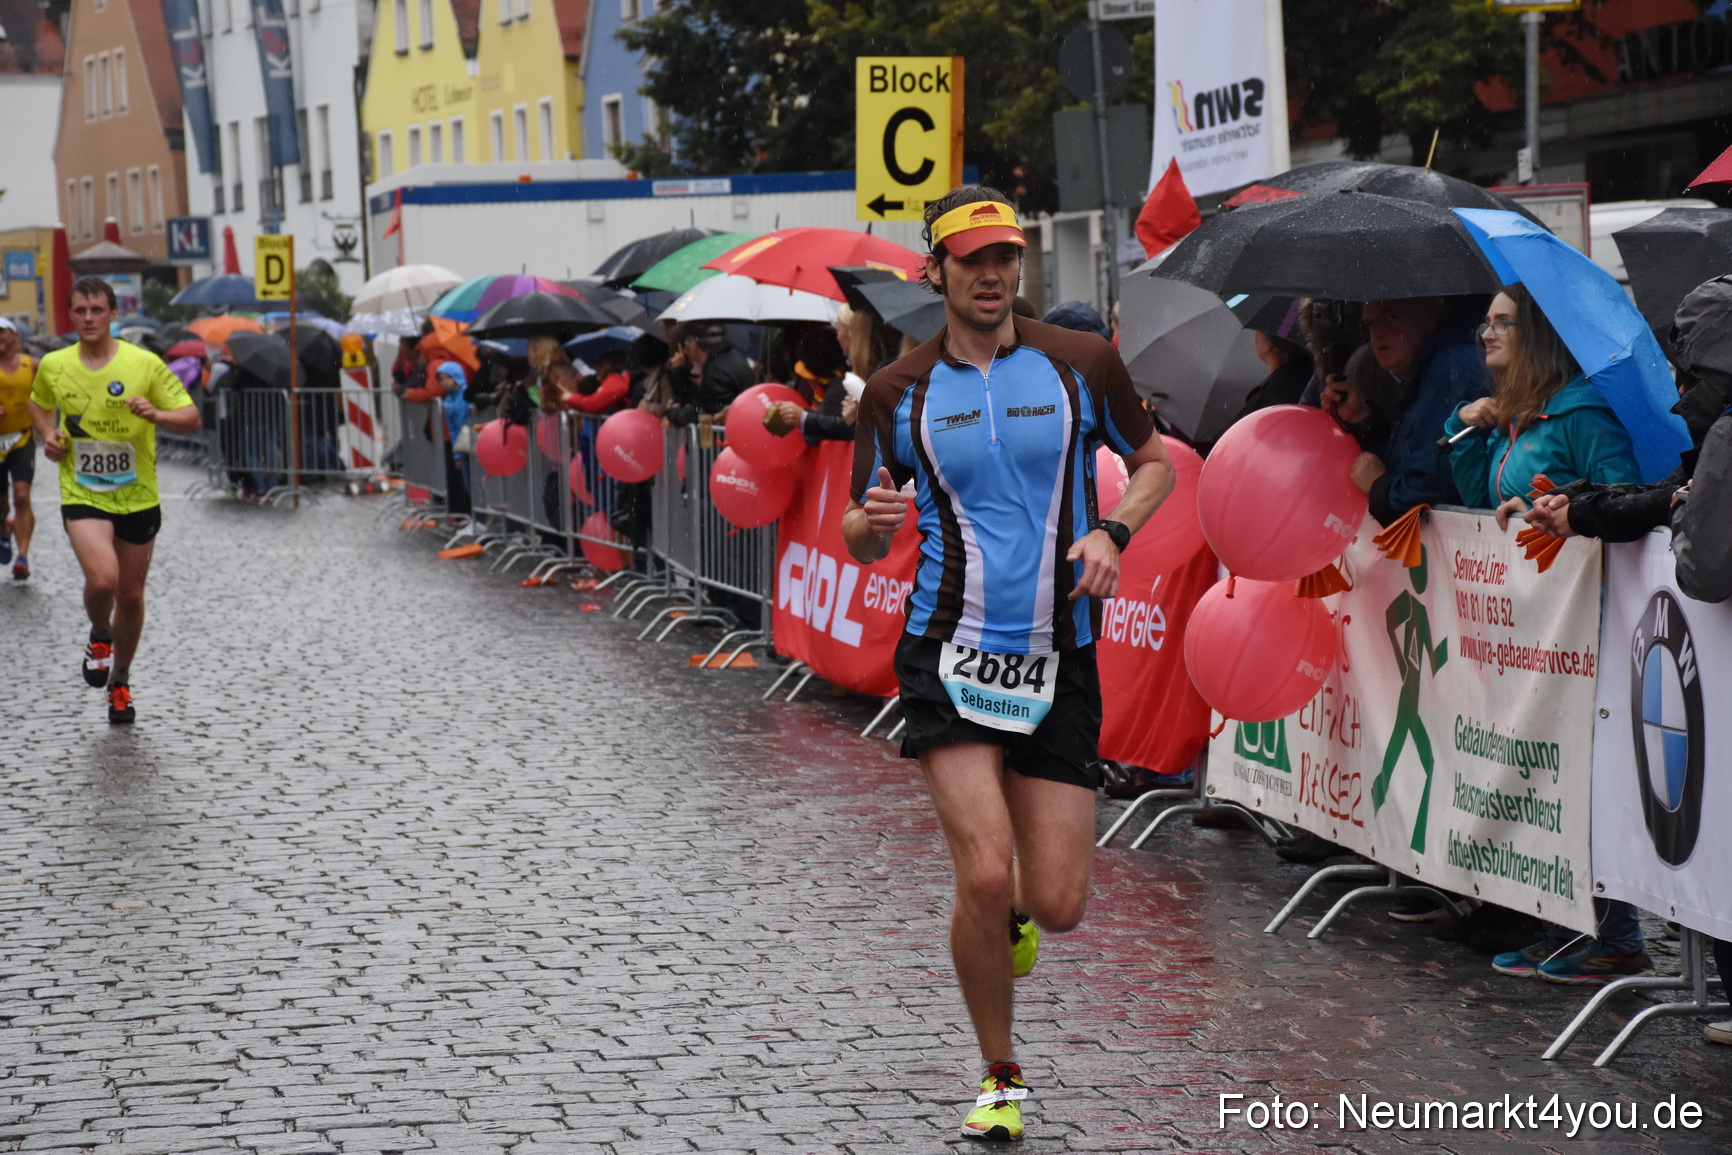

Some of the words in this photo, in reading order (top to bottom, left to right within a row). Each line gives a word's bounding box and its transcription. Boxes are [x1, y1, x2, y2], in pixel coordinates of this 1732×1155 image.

[869, 65, 951, 93] Block
[882, 106, 936, 187] C
[258, 238, 290, 249] Block
[265, 254, 284, 285] D
[80, 453, 131, 474] 2888
[1454, 550, 1508, 585] Service-Line:
[1632, 597, 1697, 689] BMW
[953, 645, 1048, 694] 2684
[961, 688, 1030, 718] Sebastian
[1453, 771, 1562, 834] Hausmeisterdienst
[1448, 829, 1574, 900] Arbeitsbühnenverleih
